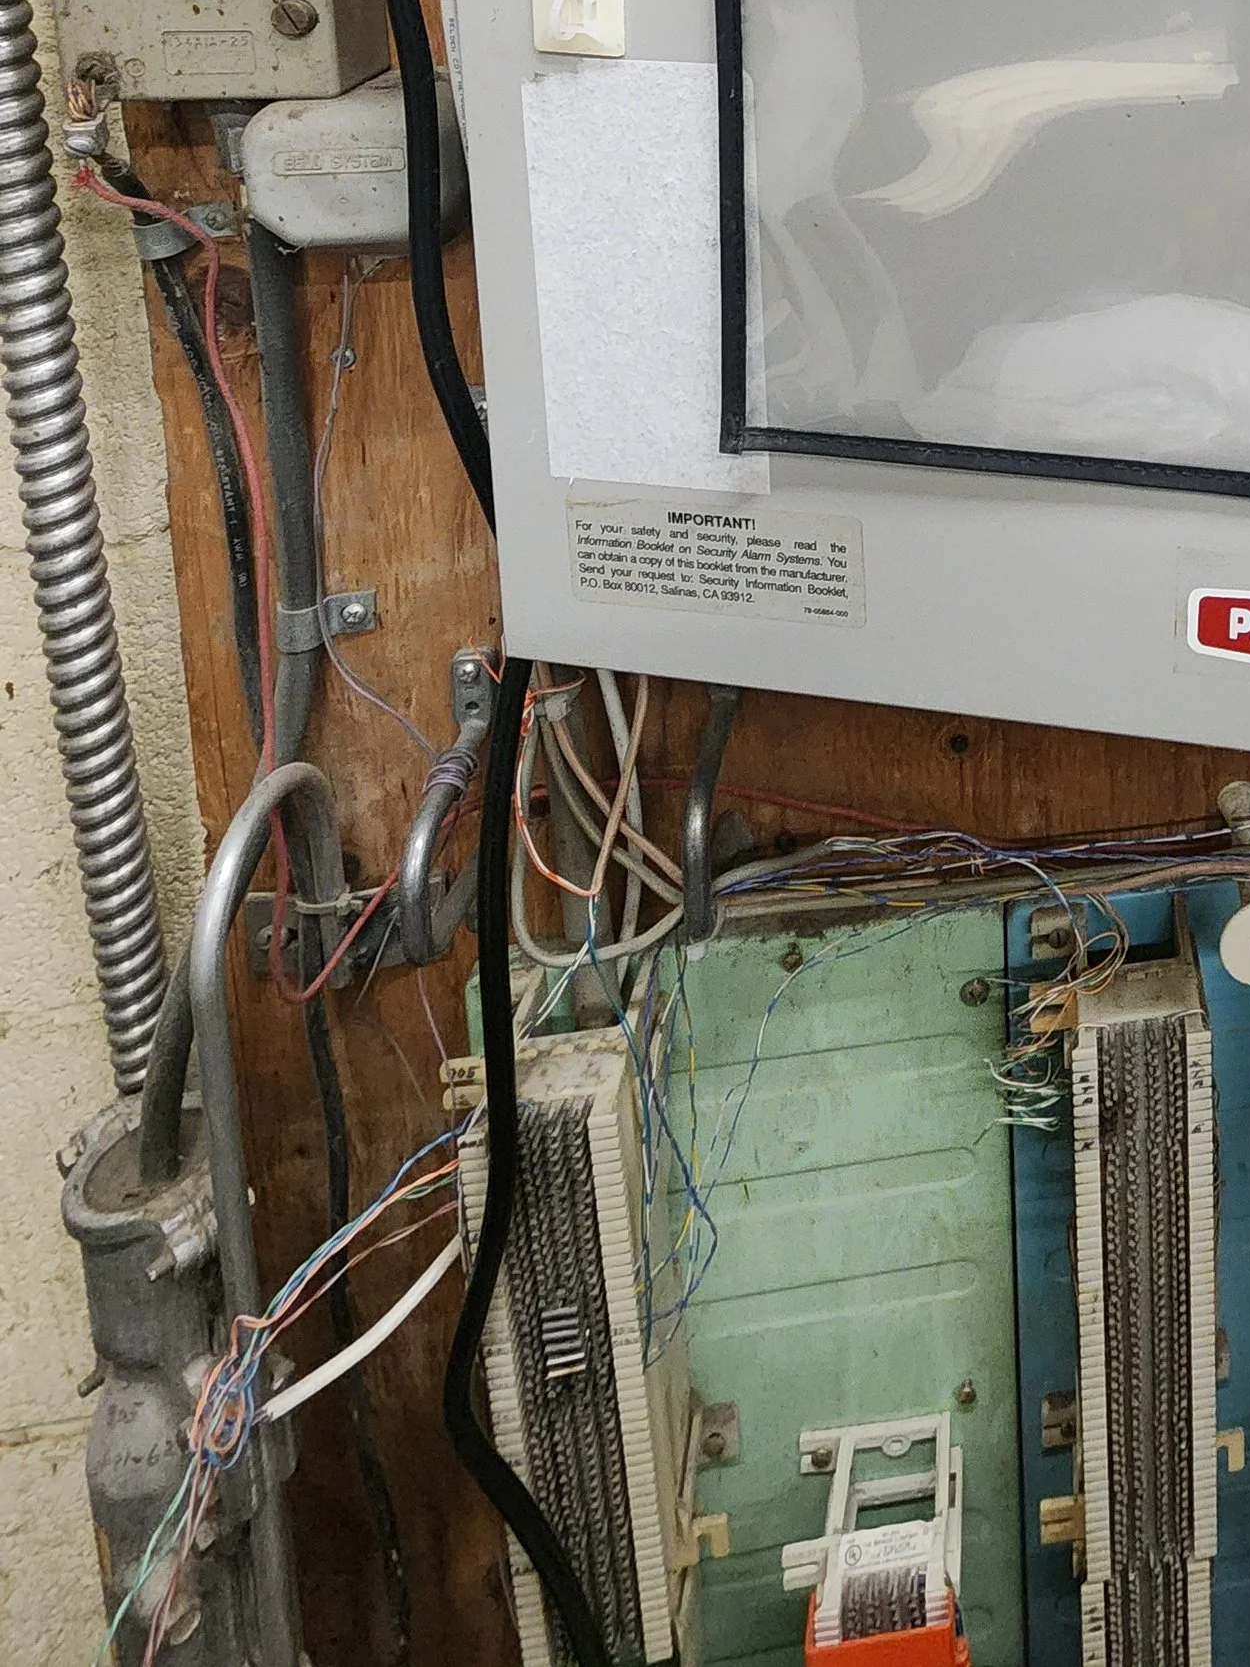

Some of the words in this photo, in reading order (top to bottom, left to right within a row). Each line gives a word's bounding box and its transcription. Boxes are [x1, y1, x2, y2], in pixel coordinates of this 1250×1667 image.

[575, 520, 592, 532] For
[600, 523, 624, 535] your
[631, 525, 661, 540] safety
[669, 529, 689, 540] and
[696, 532, 738, 546] security,
[746, 535, 781, 548] please
[793, 540, 818, 552] read
[829, 542, 847, 554] the
[667, 511, 756, 531] IMPORTANT!
[577, 534, 633, 550] Information
[636, 539, 674, 553] Booklet
[678, 545, 692, 555] on
[696, 545, 738, 561] Security
[741, 549, 772, 562] Alarm
[776, 551, 823, 567] Systems.
[827, 556, 847, 569] You
[577, 551, 596, 561] can
[597, 551, 629, 564] obtain
[630, 554, 637, 564] a
[638, 556, 663, 569] copy
[664, 557, 676, 568] of
[677, 558, 695, 570] this
[696, 560, 734, 574] booklet
[735, 562, 759, 575] from
[760, 565, 777, 577] the
[779, 567, 848, 584] manufacturer.
[579, 562, 606, 576] Send
[610, 567, 633, 579] your
[637, 568, 676, 583] request
[680, 572, 694, 585] to:
[698, 574, 740, 590] Security
[745, 578, 802, 595] Information
[807, 583, 849, 600] Booklet,
[580, 577, 601, 589] P.O.
[603, 578, 622, 591] Box
[624, 581, 659, 596] 80012,
[660, 584, 700, 600] Salinas,
[702, 588, 720, 601] CA
[720, 590, 756, 604] 93912.
